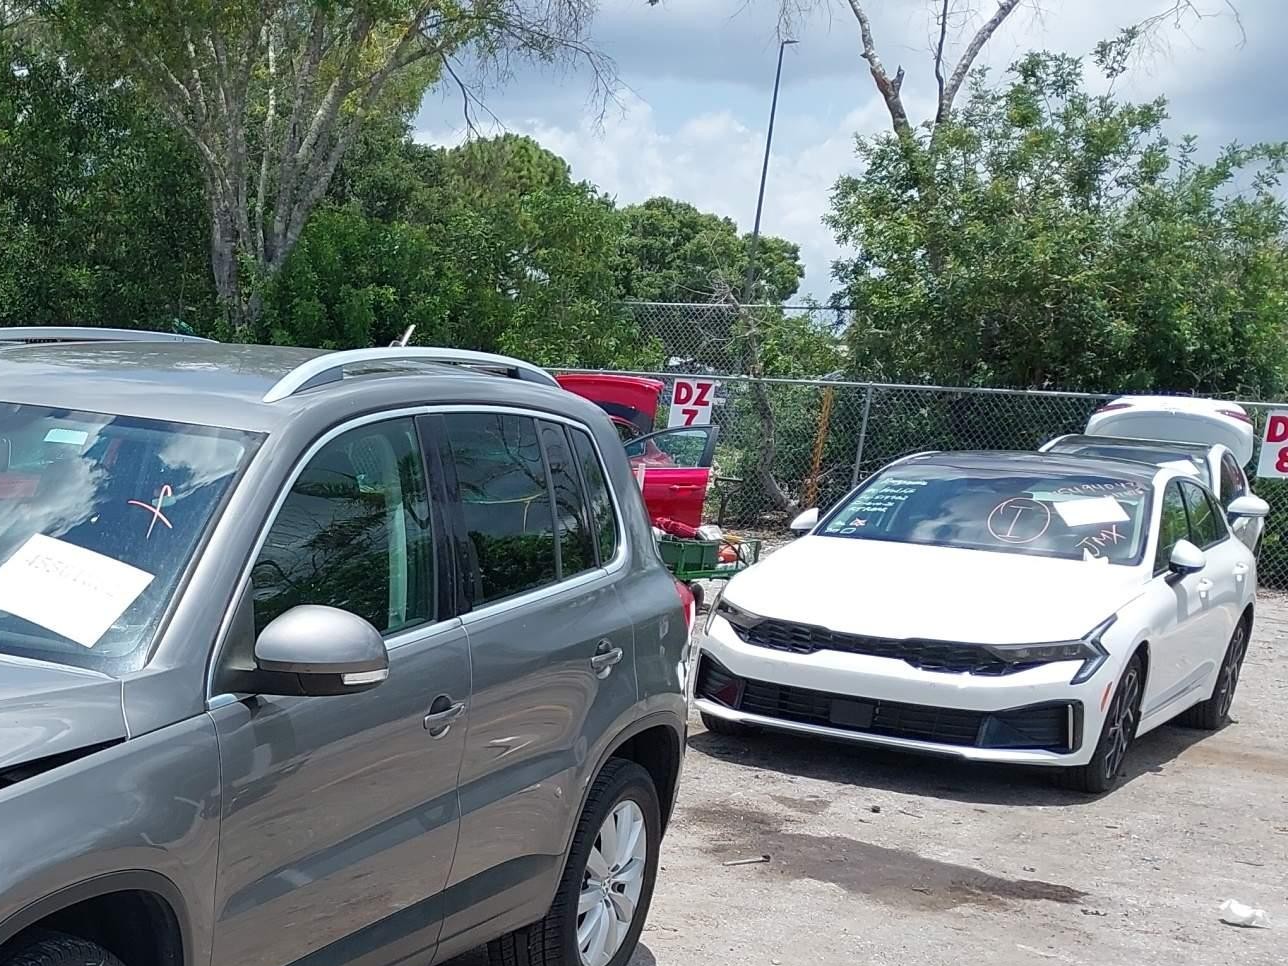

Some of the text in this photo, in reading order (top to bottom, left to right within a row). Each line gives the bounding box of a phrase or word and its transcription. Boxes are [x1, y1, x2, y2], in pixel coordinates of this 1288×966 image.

[673, 381, 713, 407] DZ
[682, 408, 699, 427] 7
[1074, 524, 1127, 557] JMX
